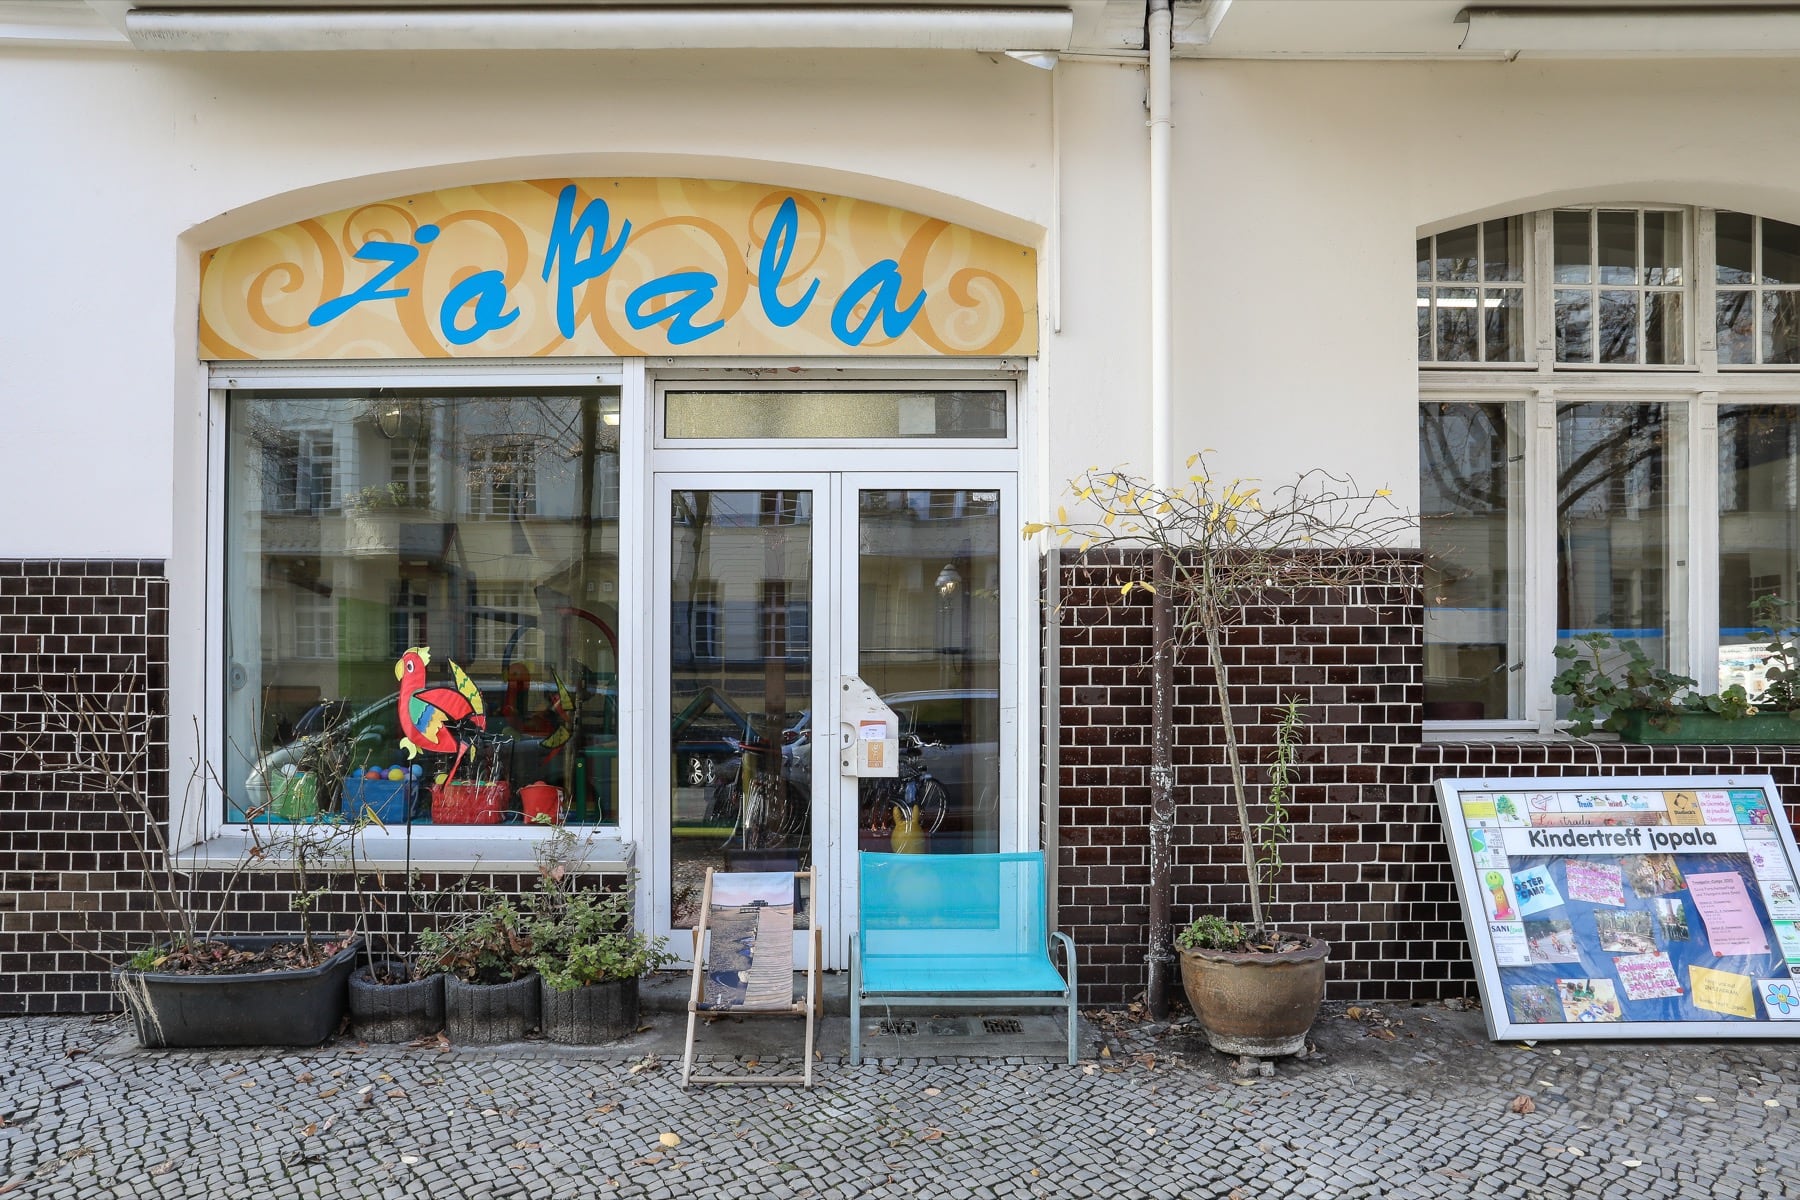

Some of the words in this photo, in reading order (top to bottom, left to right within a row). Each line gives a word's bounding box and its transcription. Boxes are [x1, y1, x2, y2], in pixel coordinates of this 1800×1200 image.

[1528, 827, 1641, 848] Kindertreff
[1648, 827, 1717, 851] jopala
[1514, 877, 1544, 892] OSTER
[1521, 886, 1545, 899] CAMP
